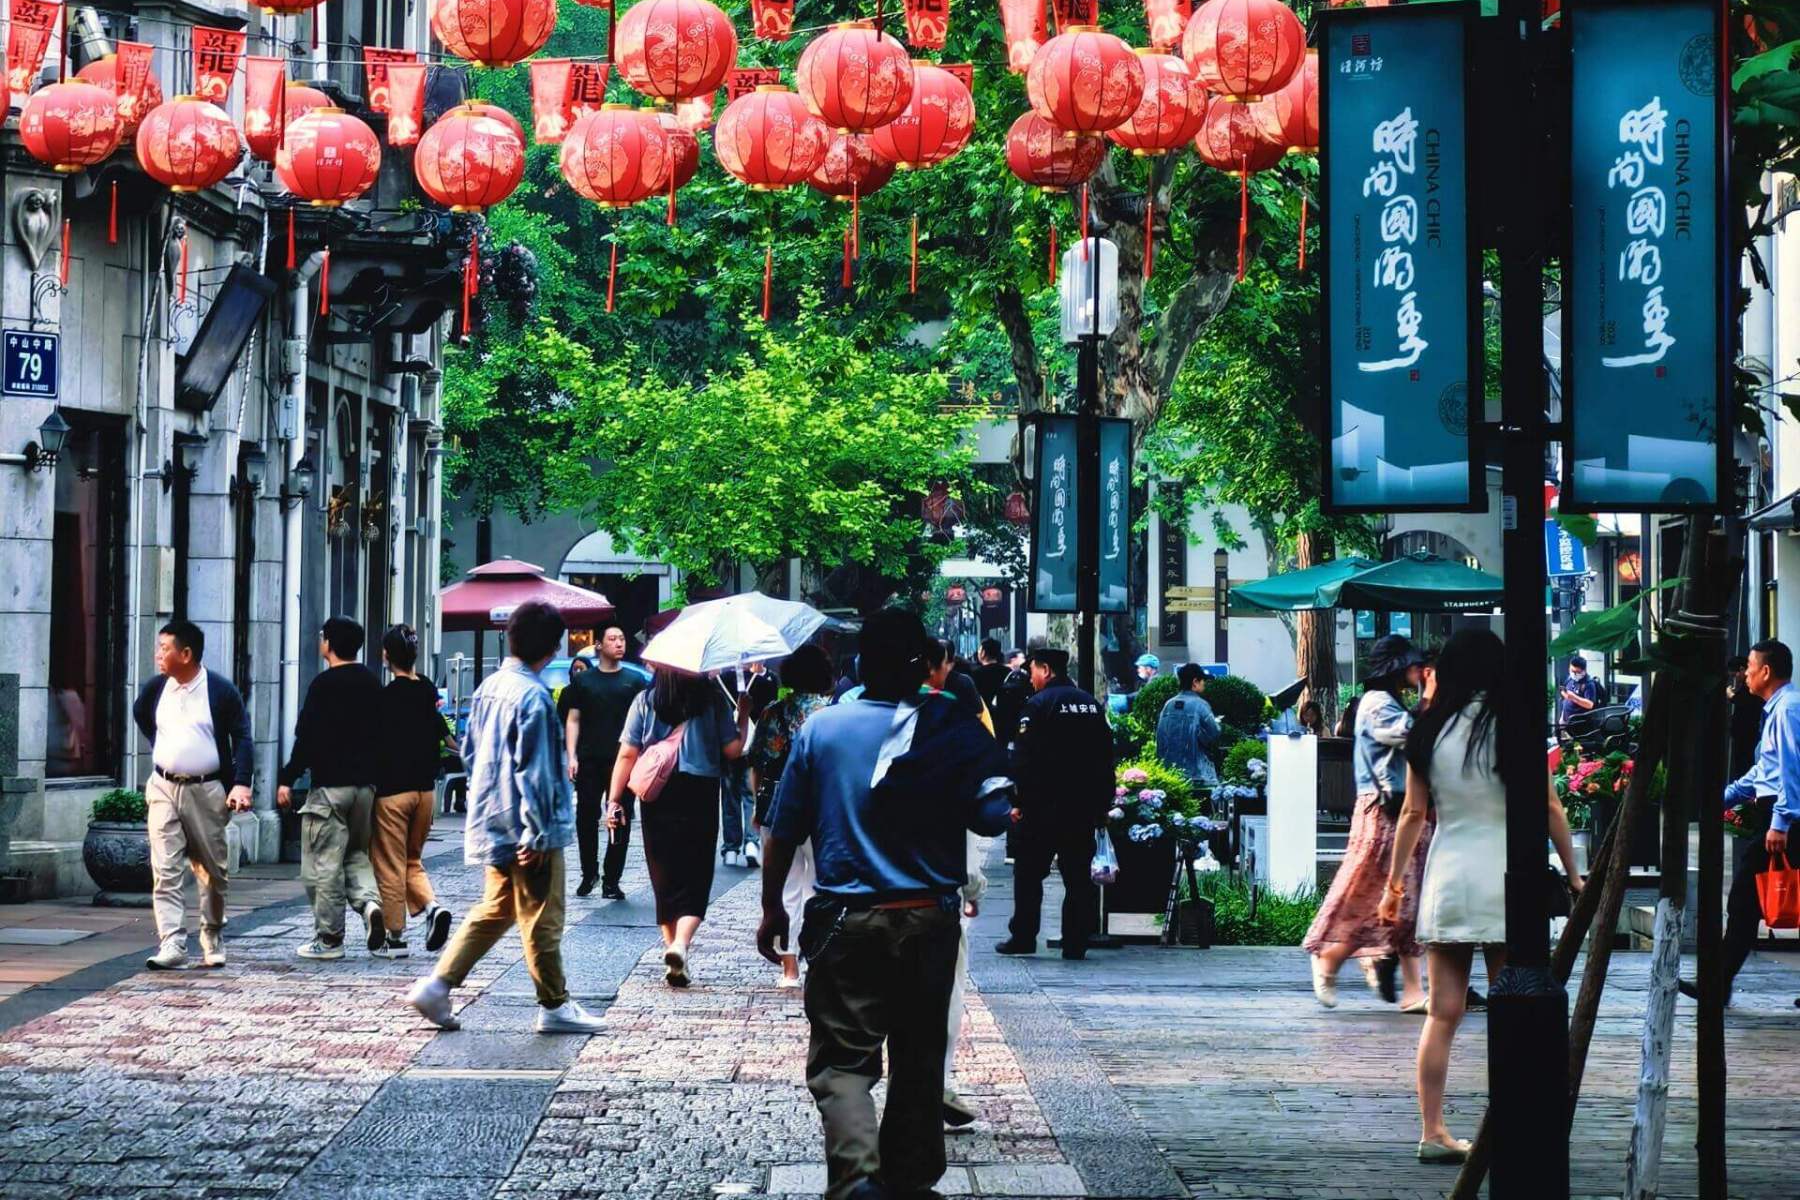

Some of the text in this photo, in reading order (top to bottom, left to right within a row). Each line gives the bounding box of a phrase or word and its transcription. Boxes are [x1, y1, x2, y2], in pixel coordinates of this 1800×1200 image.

[198, 31, 239, 74] 龍
[1425, 128, 1442, 248] CHINA CHIC
[1675, 119, 1692, 241] CHINA CHIC
[10, 336, 52, 351] 中山中路
[18, 352, 42, 381] 79
